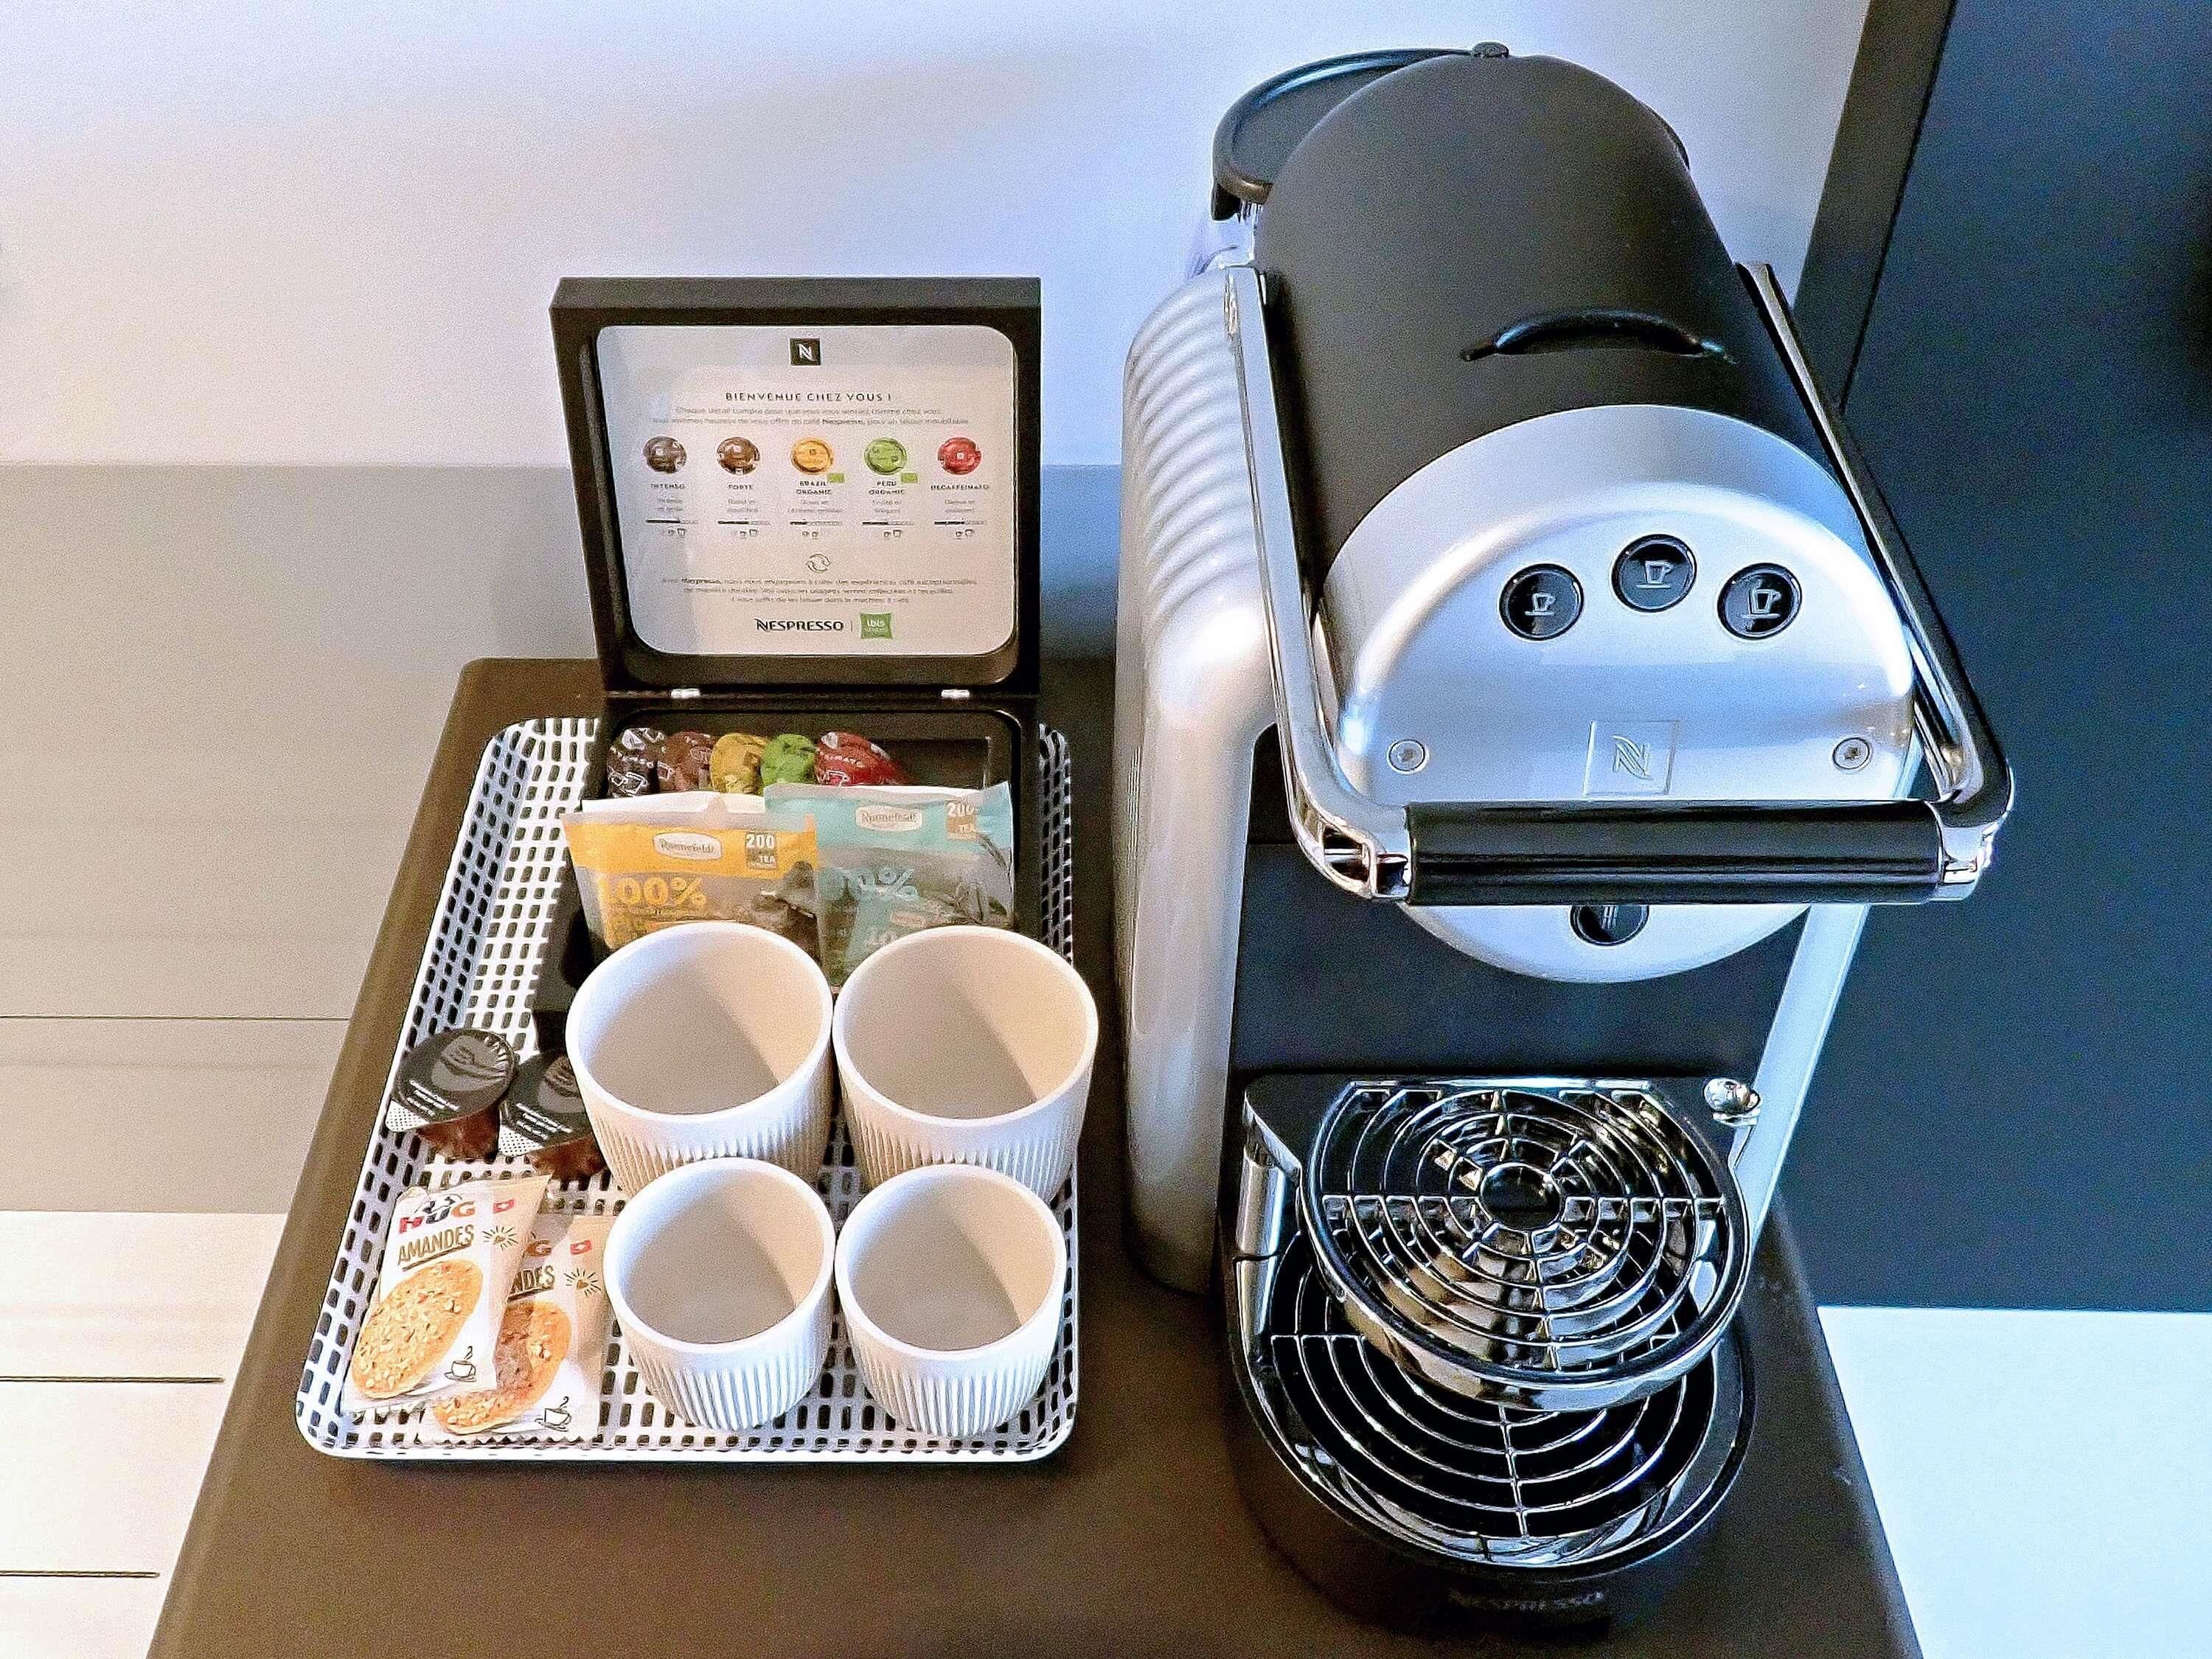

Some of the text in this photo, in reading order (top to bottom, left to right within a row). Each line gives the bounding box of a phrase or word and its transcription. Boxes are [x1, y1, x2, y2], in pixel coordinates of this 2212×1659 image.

[725, 392, 801, 402] BIENVENUE
[807, 392, 842, 402] CHEZ
[846, 392, 883, 402] VOUS
[754, 618, 844, 633] NESPRESSO
[745, 833, 775, 849] 200
[759, 855, 776, 863] TEA
[399, 1200, 476, 1234] HUG
[398, 1224, 475, 1266] AMANDES
[511, 1265, 555, 1293] NDES
